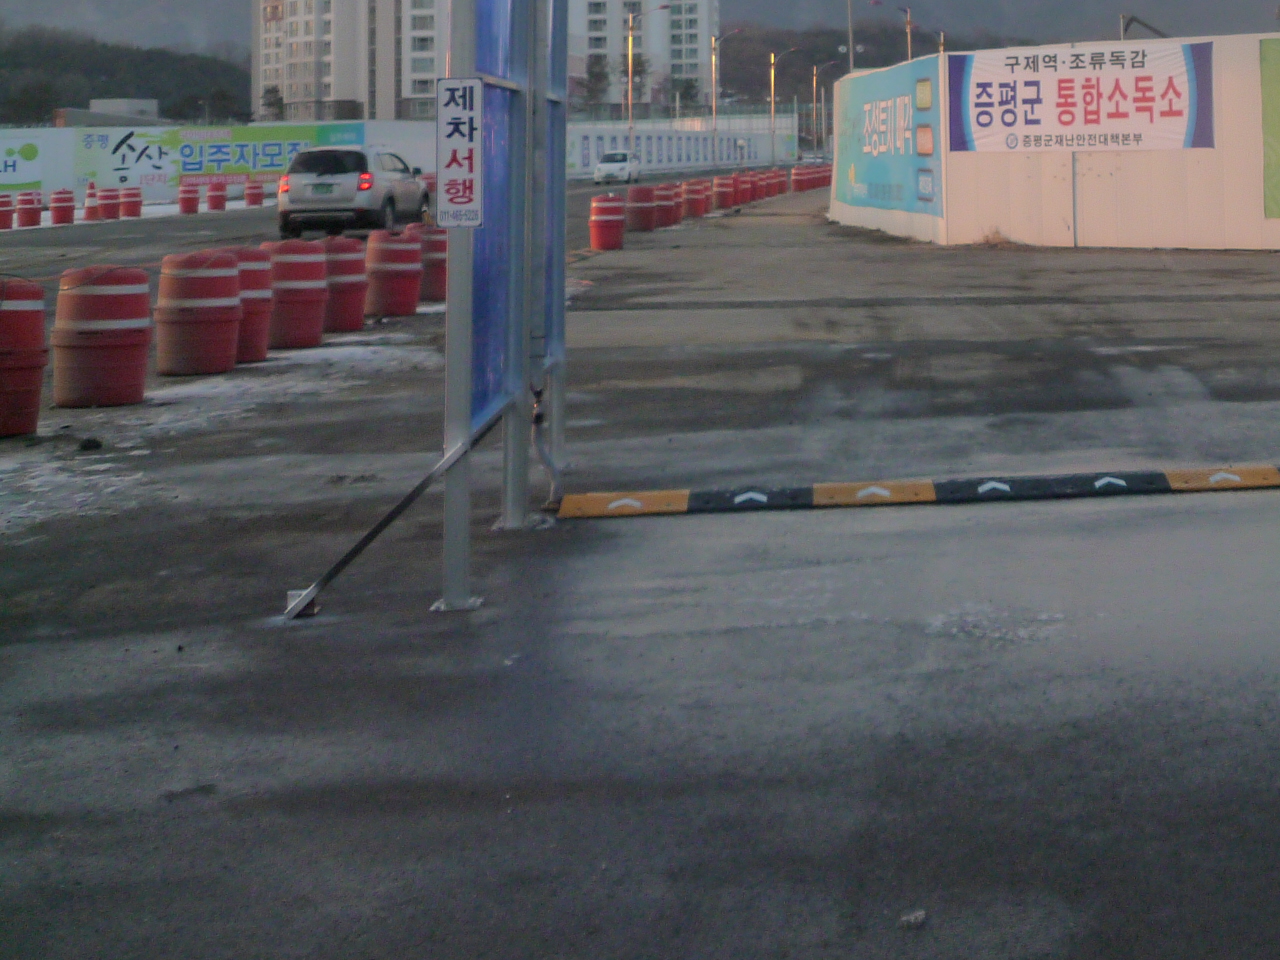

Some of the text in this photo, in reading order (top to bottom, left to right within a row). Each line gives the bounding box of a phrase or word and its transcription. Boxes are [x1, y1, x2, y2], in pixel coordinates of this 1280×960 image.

[974, 75, 1184, 128] 증평군 통합소독소
[83, 133, 109, 150] 증평
